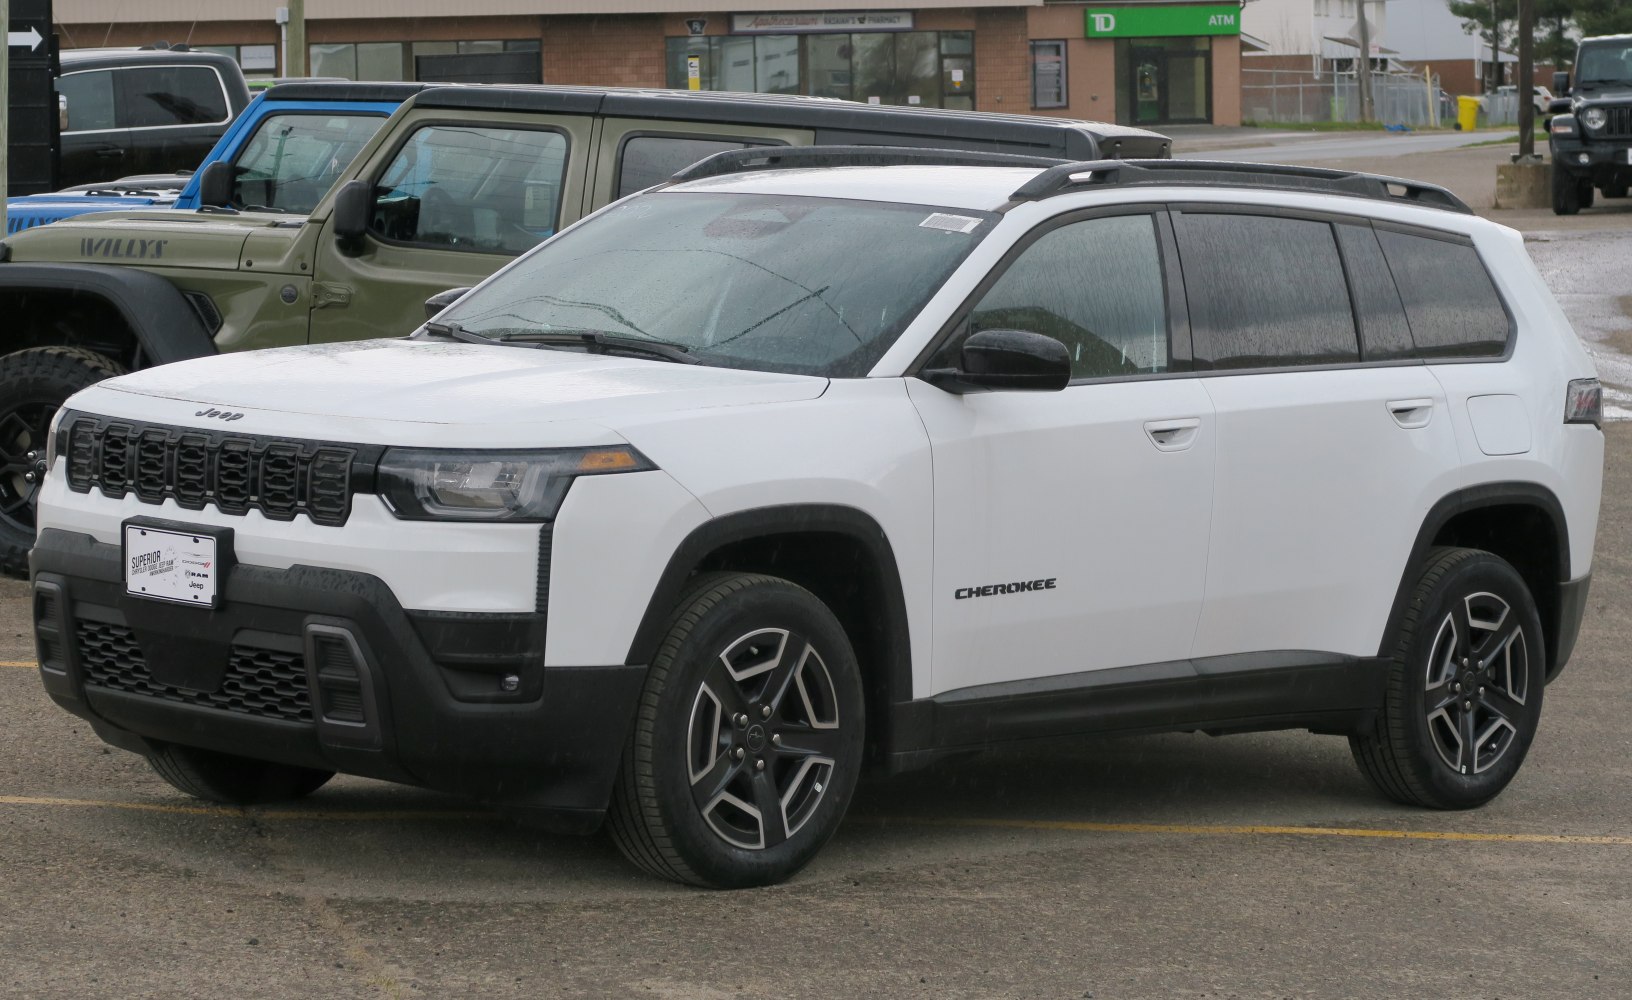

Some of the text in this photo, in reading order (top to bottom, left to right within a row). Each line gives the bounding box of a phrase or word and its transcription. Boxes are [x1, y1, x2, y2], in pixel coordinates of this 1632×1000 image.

[867, 15, 901, 25] PHARMACY
[1089, 13, 1116, 32] TD
[1208, 14, 1235, 26] ATM
[80, 237, 168, 259] WILLYS
[195, 408, 244, 421] Jeep
[131, 550, 161, 569] SUPERIOR
[189, 581, 204, 590] Jeep
[954, 578, 1057, 600] CHEROKEE
